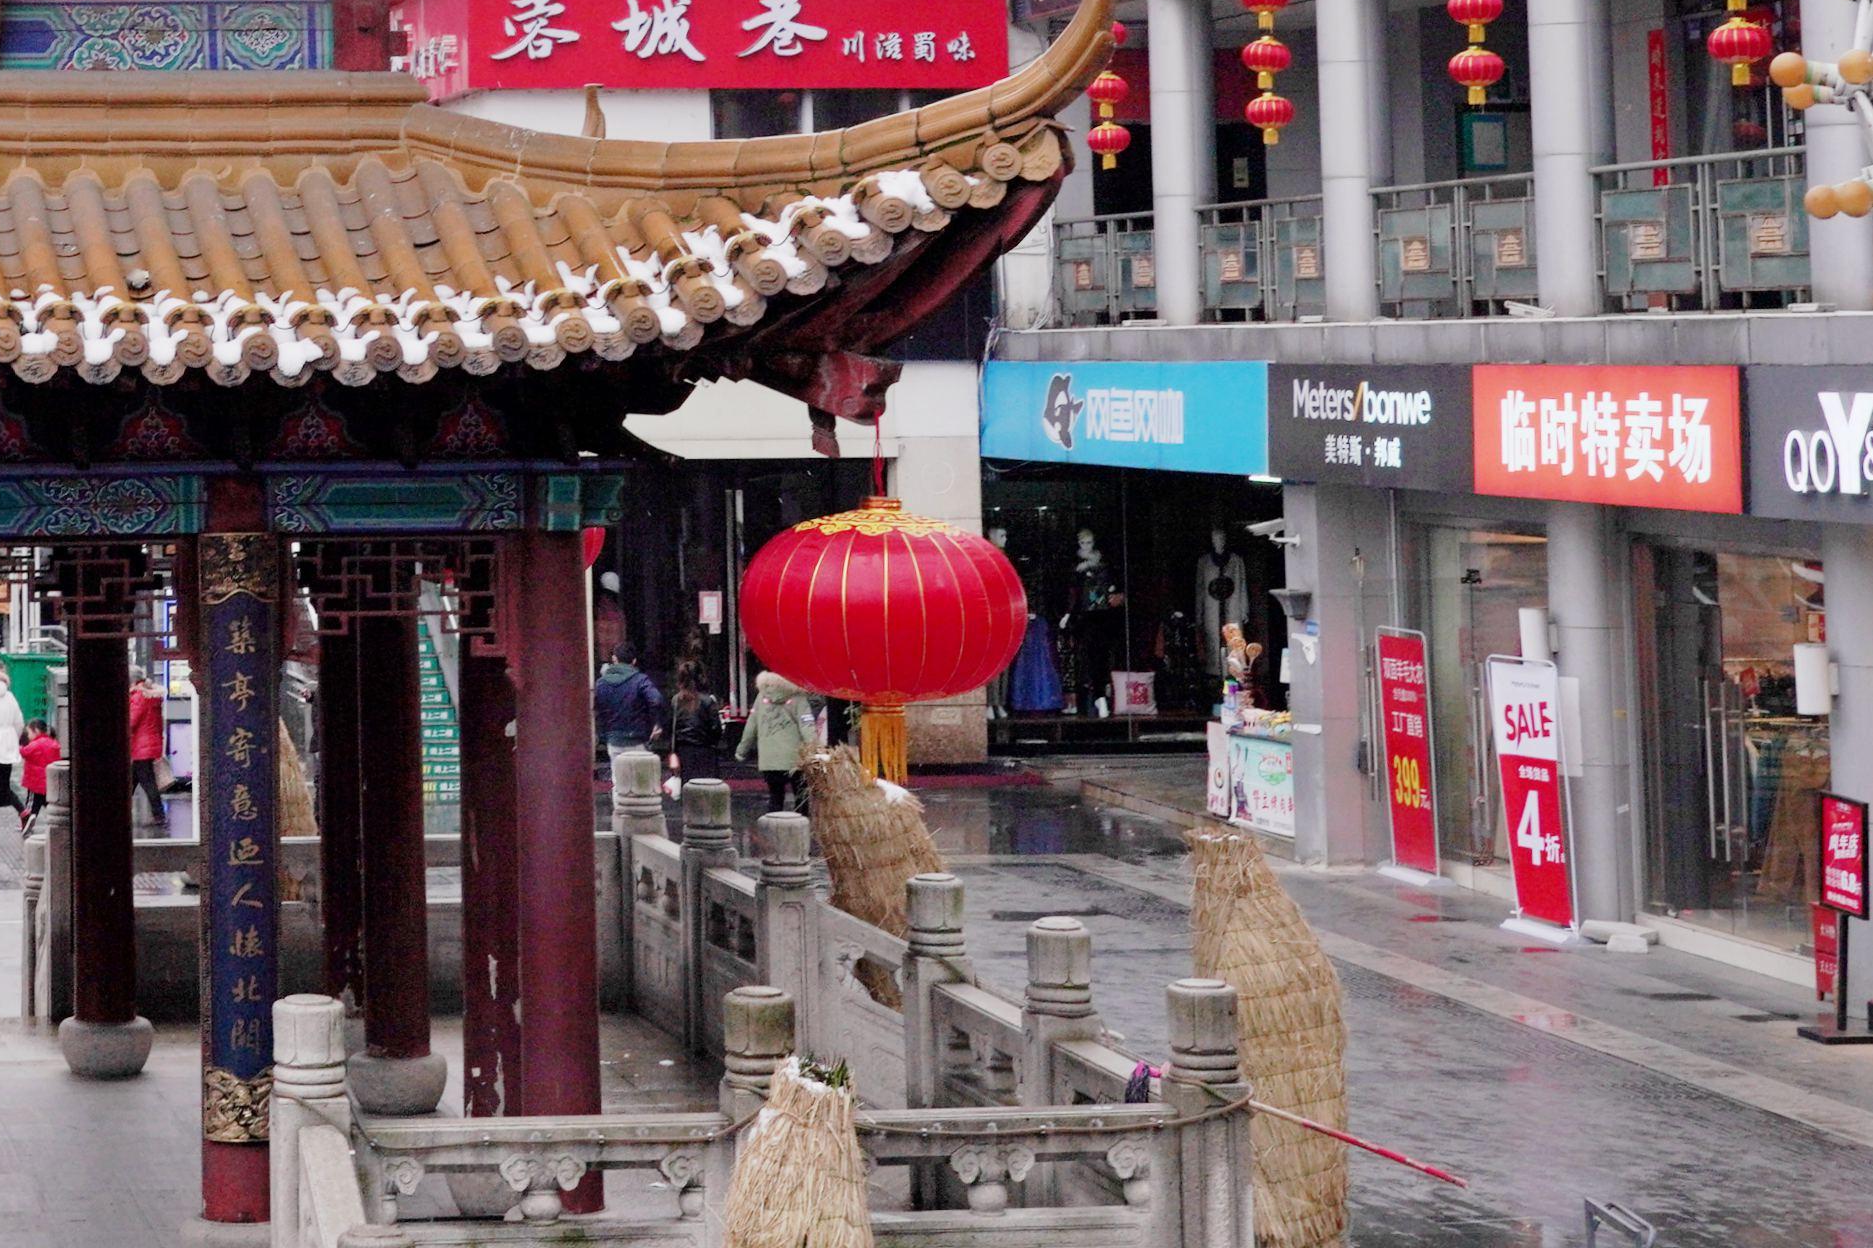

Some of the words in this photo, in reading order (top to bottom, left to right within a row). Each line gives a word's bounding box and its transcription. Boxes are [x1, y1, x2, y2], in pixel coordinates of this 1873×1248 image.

[841, 31, 976, 64] 川滋蜀味
[1085, 386, 1185, 445] 网鱼网咖
[1293, 378, 1431, 426] Meters/bonwe
[1500, 389, 1712, 484] 临时特卖场
[1504, 701, 1554, 751] SALE
